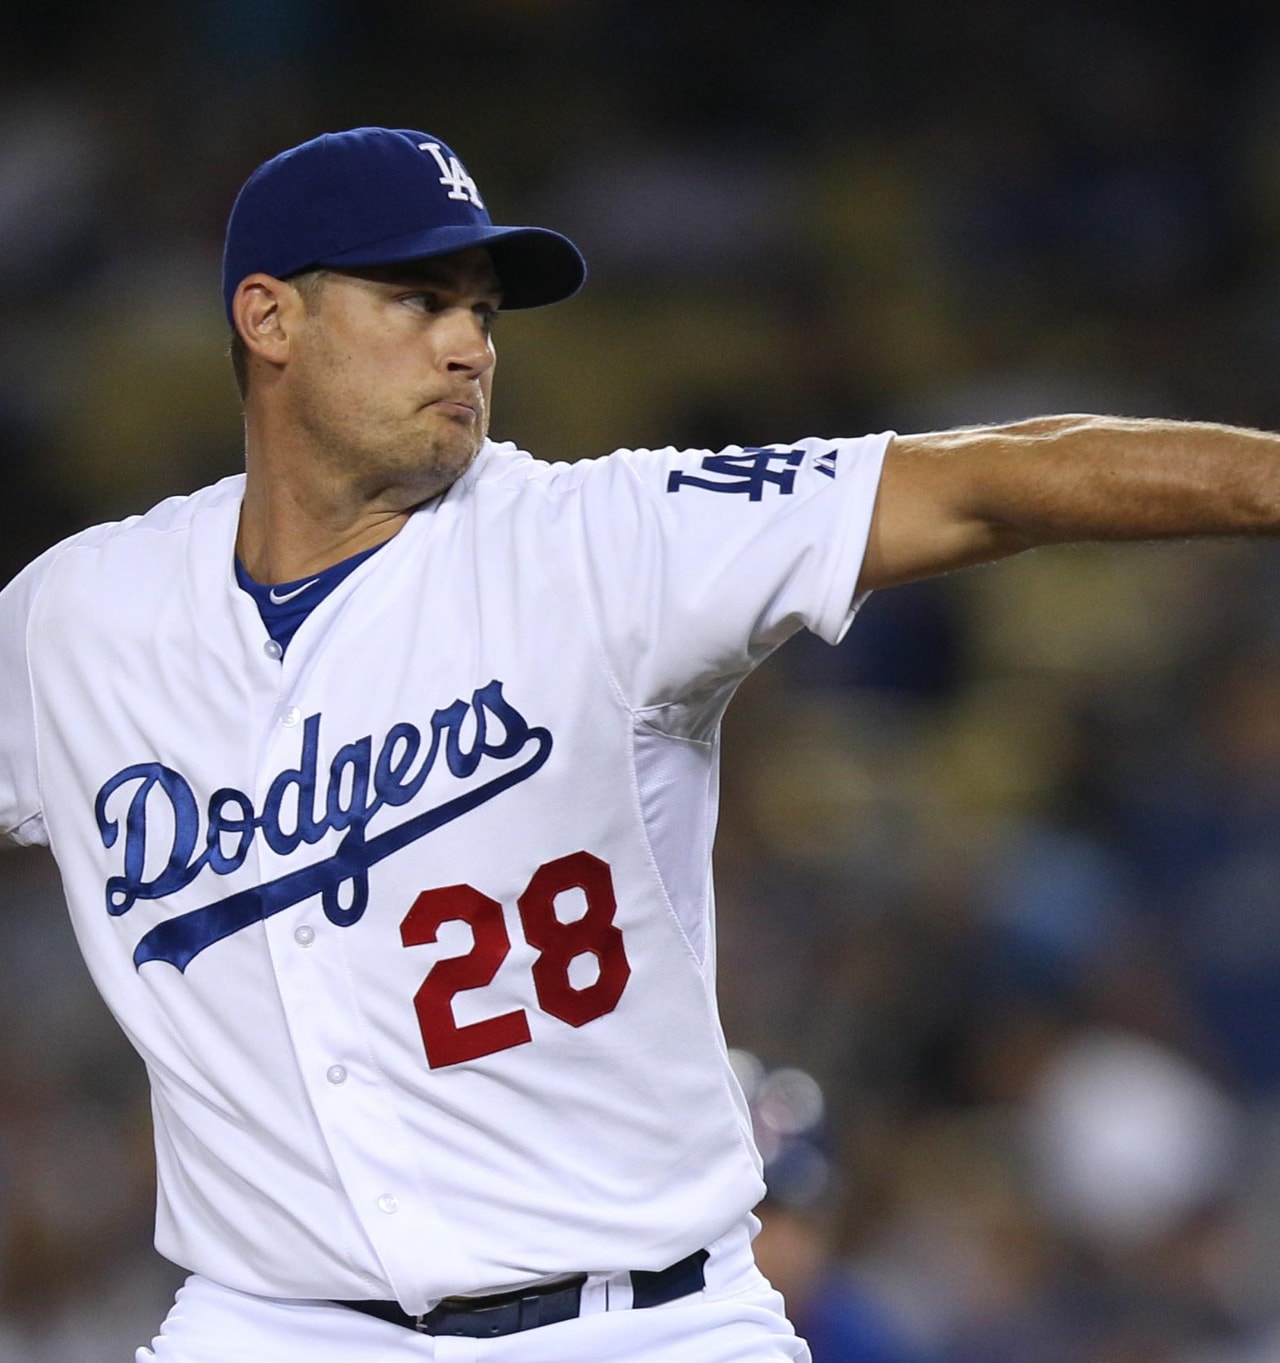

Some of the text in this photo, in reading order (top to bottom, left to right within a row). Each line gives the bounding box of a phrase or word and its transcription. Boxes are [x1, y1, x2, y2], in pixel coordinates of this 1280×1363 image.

[418, 142, 484, 210] LA
[666, 447, 806, 502] LA
[94, 679, 553, 974] Dodgers
[399, 850, 632, 1070] 28
